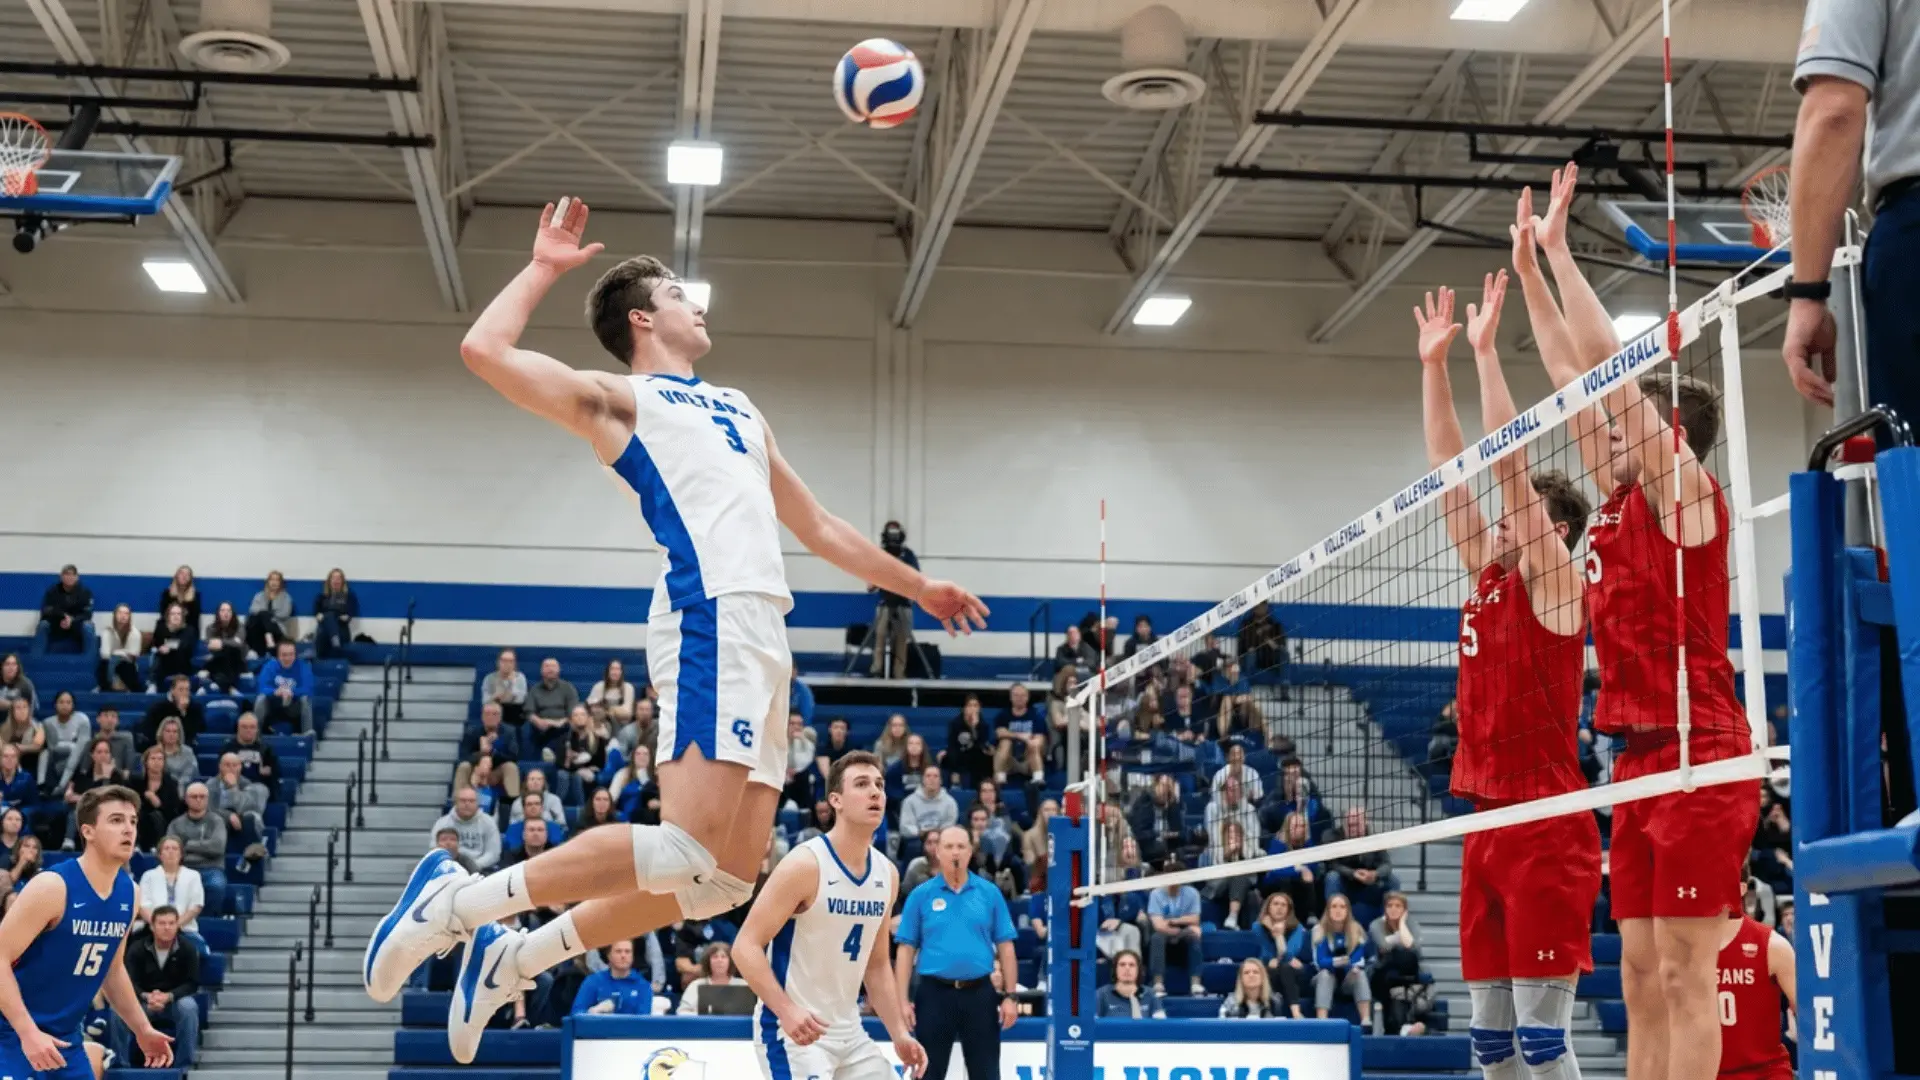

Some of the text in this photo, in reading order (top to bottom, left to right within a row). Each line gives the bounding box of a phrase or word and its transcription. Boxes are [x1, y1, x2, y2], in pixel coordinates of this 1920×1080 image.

[711, 416, 747, 454] 3
[1393, 469, 1444, 514] VOLLEYBALL
[1478, 408, 1540, 461] VOLLEYBALL
[1583, 332, 1660, 396] VOLLEYBALL
[1461, 613, 1478, 657] 5
[72, 919, 127, 938] VOLLEANS
[843, 924, 864, 961] 4
[73, 943, 109, 977] 15
